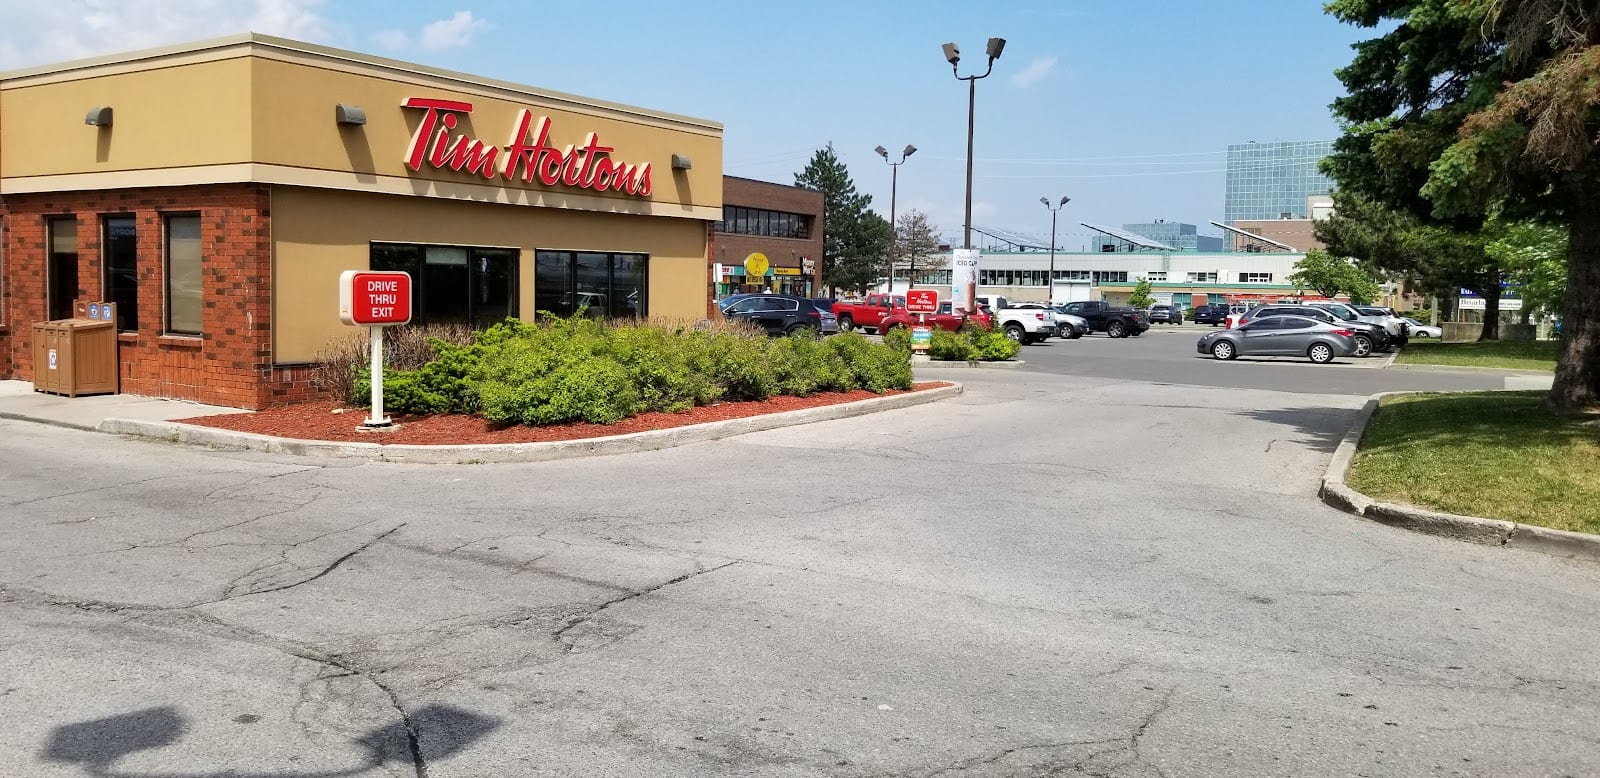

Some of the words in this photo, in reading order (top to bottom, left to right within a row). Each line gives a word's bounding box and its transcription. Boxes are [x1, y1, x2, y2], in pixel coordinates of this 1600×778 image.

[401, 97, 499, 179] Tim
[501, 108, 652, 197] Hortons
[367, 281, 398, 292] DRIVE
[369, 294, 397, 305] THRU
[371, 307, 395, 318] EXIT
